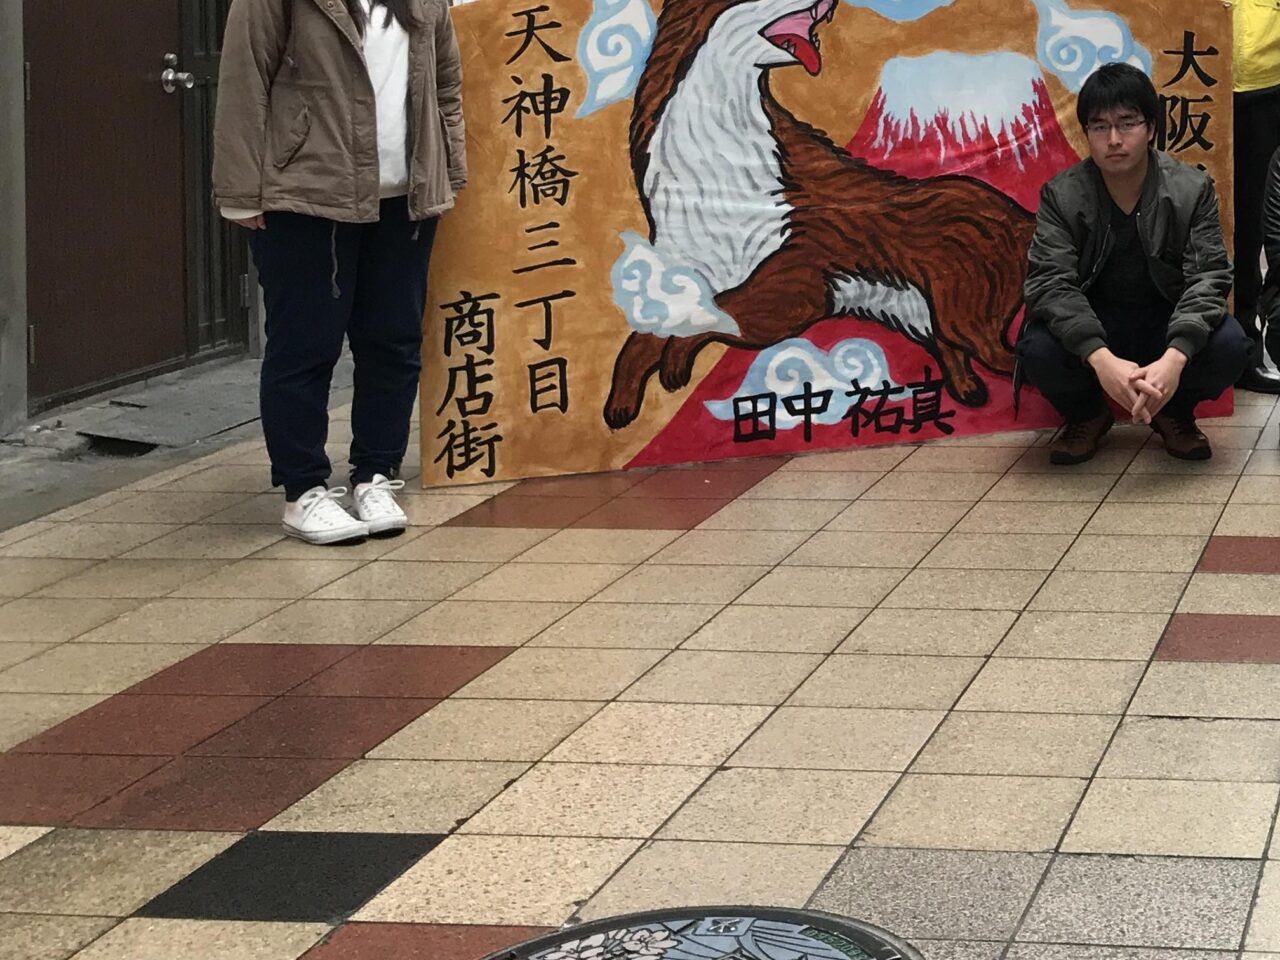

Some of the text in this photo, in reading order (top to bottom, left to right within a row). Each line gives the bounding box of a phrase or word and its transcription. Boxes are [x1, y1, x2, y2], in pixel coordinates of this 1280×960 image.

[1157, 30, 1220, 165] 大阪
[501, 4, 580, 415] 天神橋三丁目
[434, 290, 504, 480] 商店街
[732, 366, 958, 444] 田中祐真
